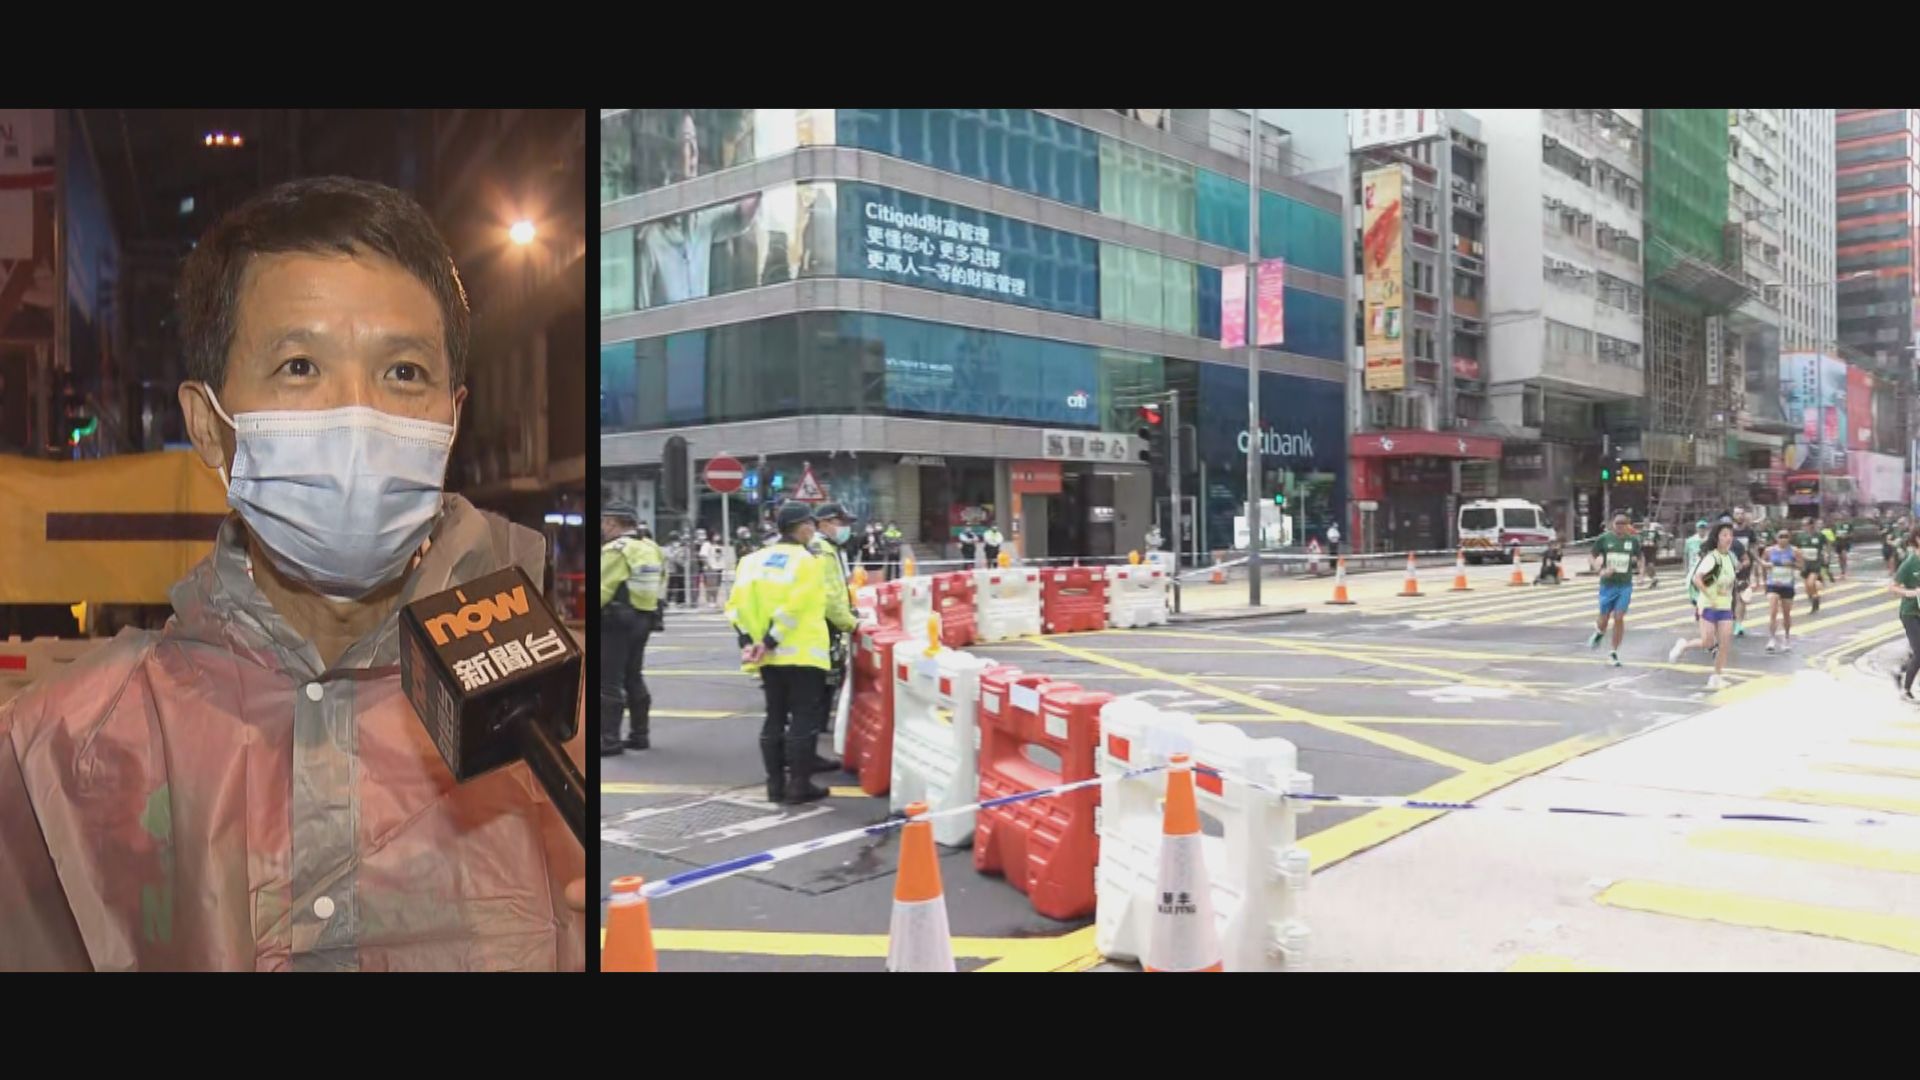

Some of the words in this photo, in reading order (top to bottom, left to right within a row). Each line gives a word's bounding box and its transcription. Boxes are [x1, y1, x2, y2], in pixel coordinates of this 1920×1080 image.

[867, 226, 935, 256] 更懂您心
[939, 241, 1001, 269] 更多選擇
[1237, 426, 1314, 457] ctibank
[424, 584, 530, 646] now
[453, 628, 567, 691] 新聞台
